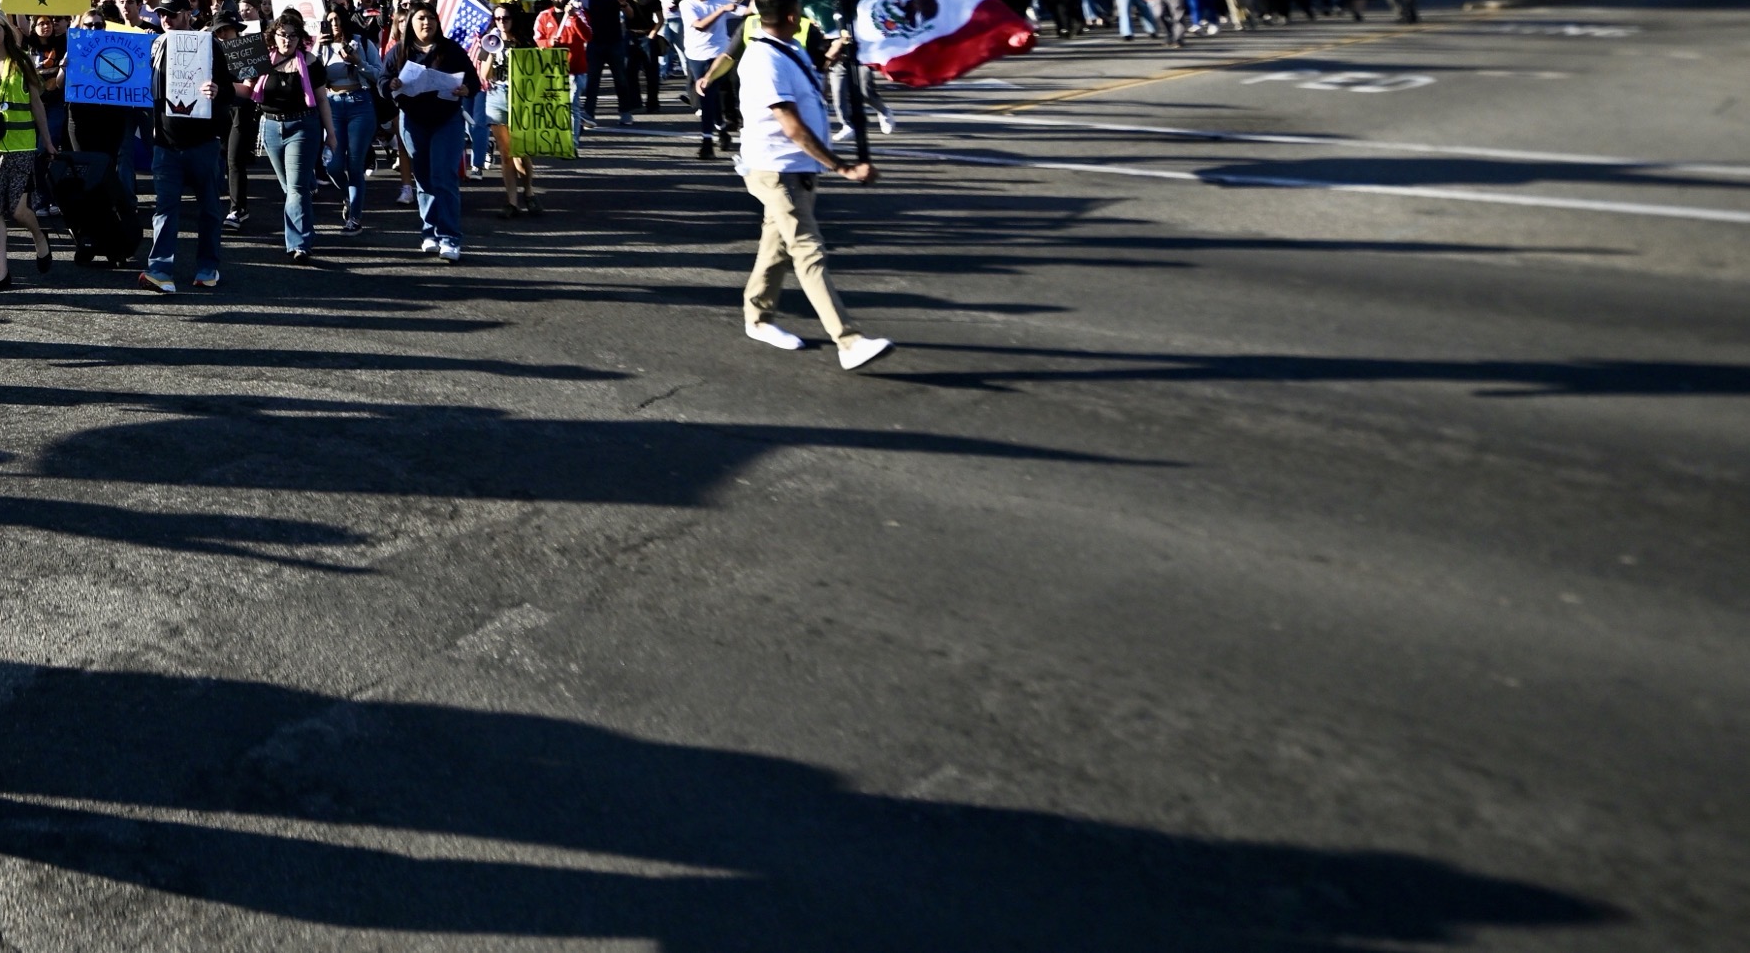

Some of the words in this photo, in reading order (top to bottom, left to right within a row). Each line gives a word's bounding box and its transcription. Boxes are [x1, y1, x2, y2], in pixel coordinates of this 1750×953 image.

[81, 37, 101, 58] KEEP
[104, 35, 145, 59] FAMILIES
[240, 48, 254, 57] GET
[511, 49, 535, 77] NO
[70, 84, 153, 103] TOGETHER
[511, 78, 535, 104] NO
[511, 105, 531, 132] NO
